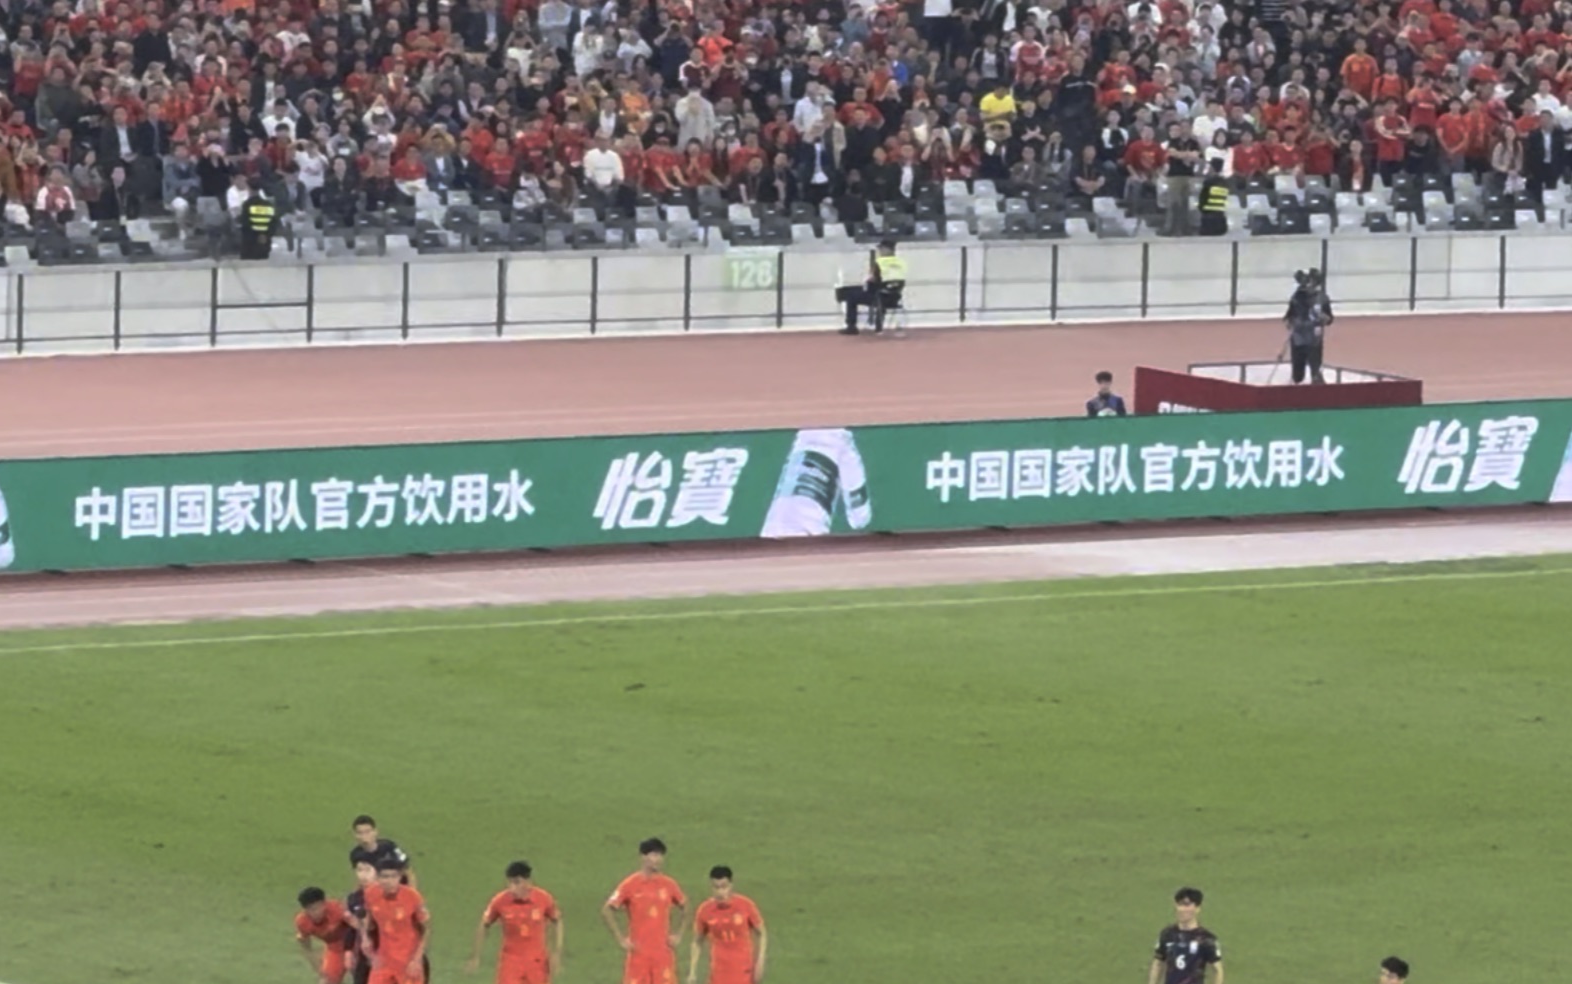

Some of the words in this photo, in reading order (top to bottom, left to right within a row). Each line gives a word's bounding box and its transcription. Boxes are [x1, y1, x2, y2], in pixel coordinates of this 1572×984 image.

[593, 447, 749, 530] 怡寶
[926, 436, 1345, 502] 中国国家队官方饮用水
[1397, 415, 1539, 494] 怡寶
[74, 469, 535, 541] 中国国家队官方饮用水
[1175, 954, 1187, 970] 6
